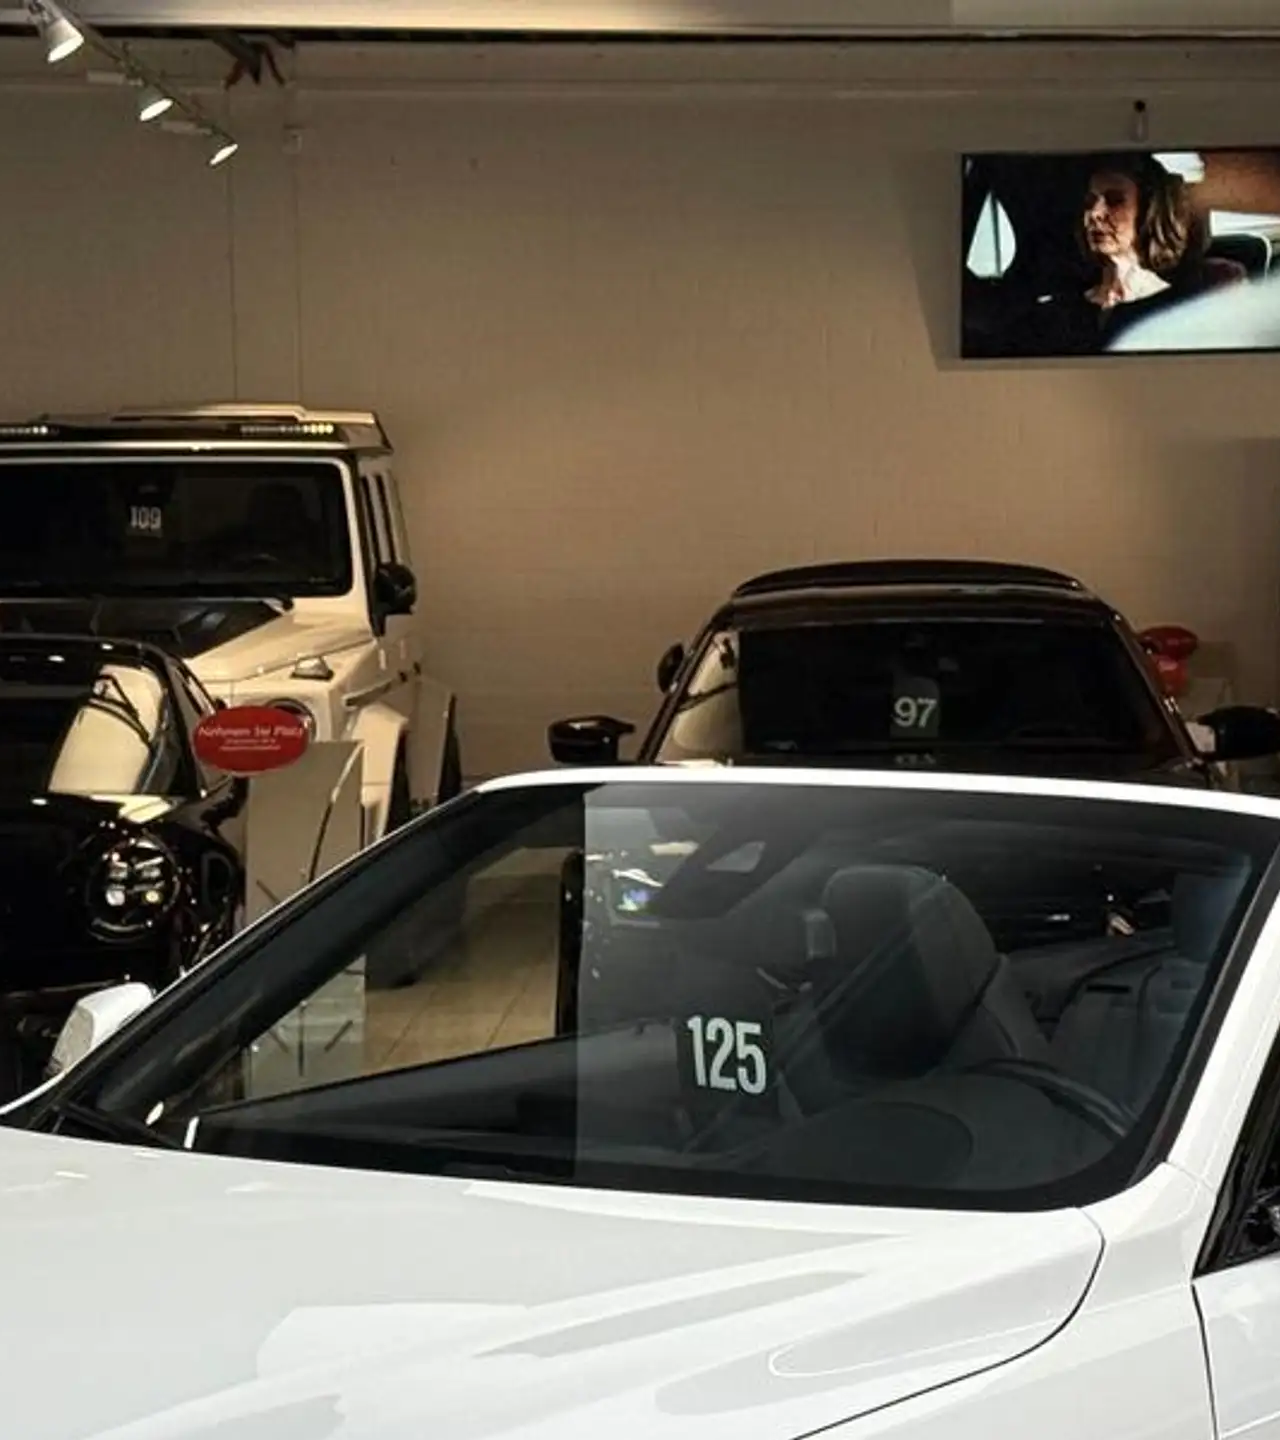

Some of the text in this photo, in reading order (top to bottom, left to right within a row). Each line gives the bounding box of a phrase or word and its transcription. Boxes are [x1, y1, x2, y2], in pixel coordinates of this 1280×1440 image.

[130, 505, 162, 529] 109
[894, 696, 937, 728] 97
[686, 1015, 767, 1094] 125
